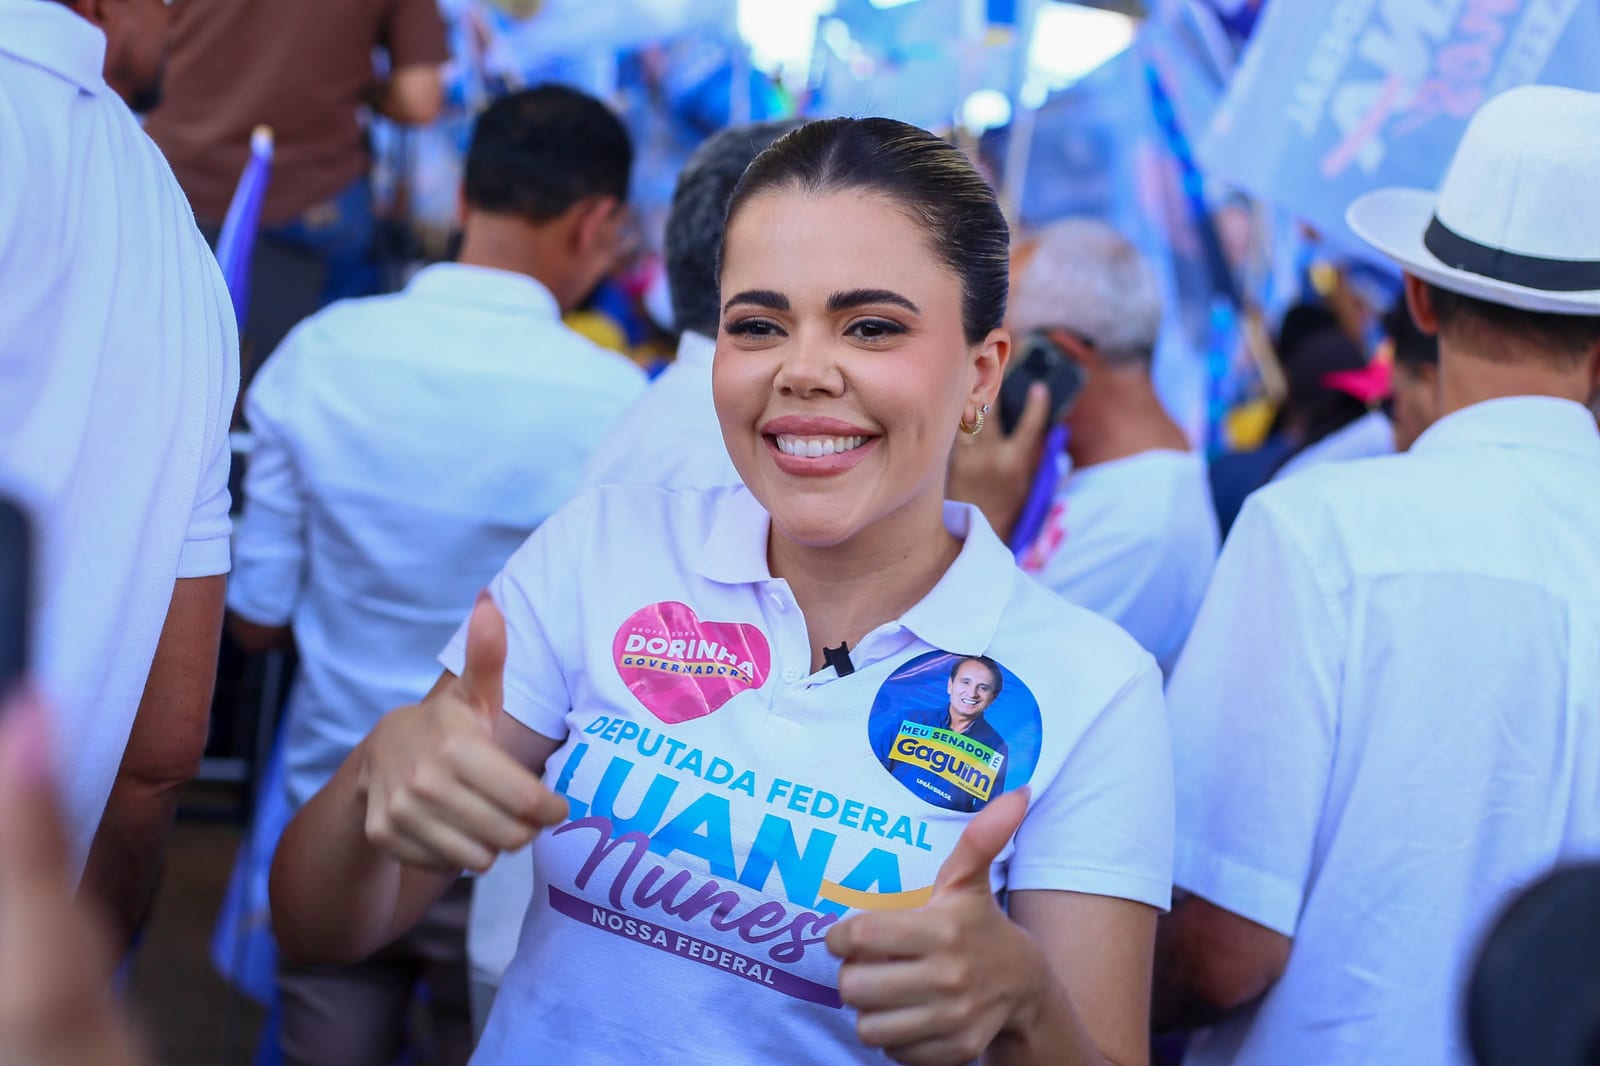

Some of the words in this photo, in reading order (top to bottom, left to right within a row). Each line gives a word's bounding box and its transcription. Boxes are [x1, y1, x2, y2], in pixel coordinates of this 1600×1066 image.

[624, 634, 754, 679] DORINHA
[897, 738, 991, 793] Gaguim
[900, 724, 929, 737] MEU
[931, 731, 991, 763] SENADOR
[584, 715, 756, 798] DEPUTADA
[766, 778, 933, 852] FEDERAL
[555, 742, 905, 919] LUANA
[552, 816, 839, 963] Nunes
[592, 907, 668, 948] NOSSA
[674, 936, 775, 985] FEDERAL
